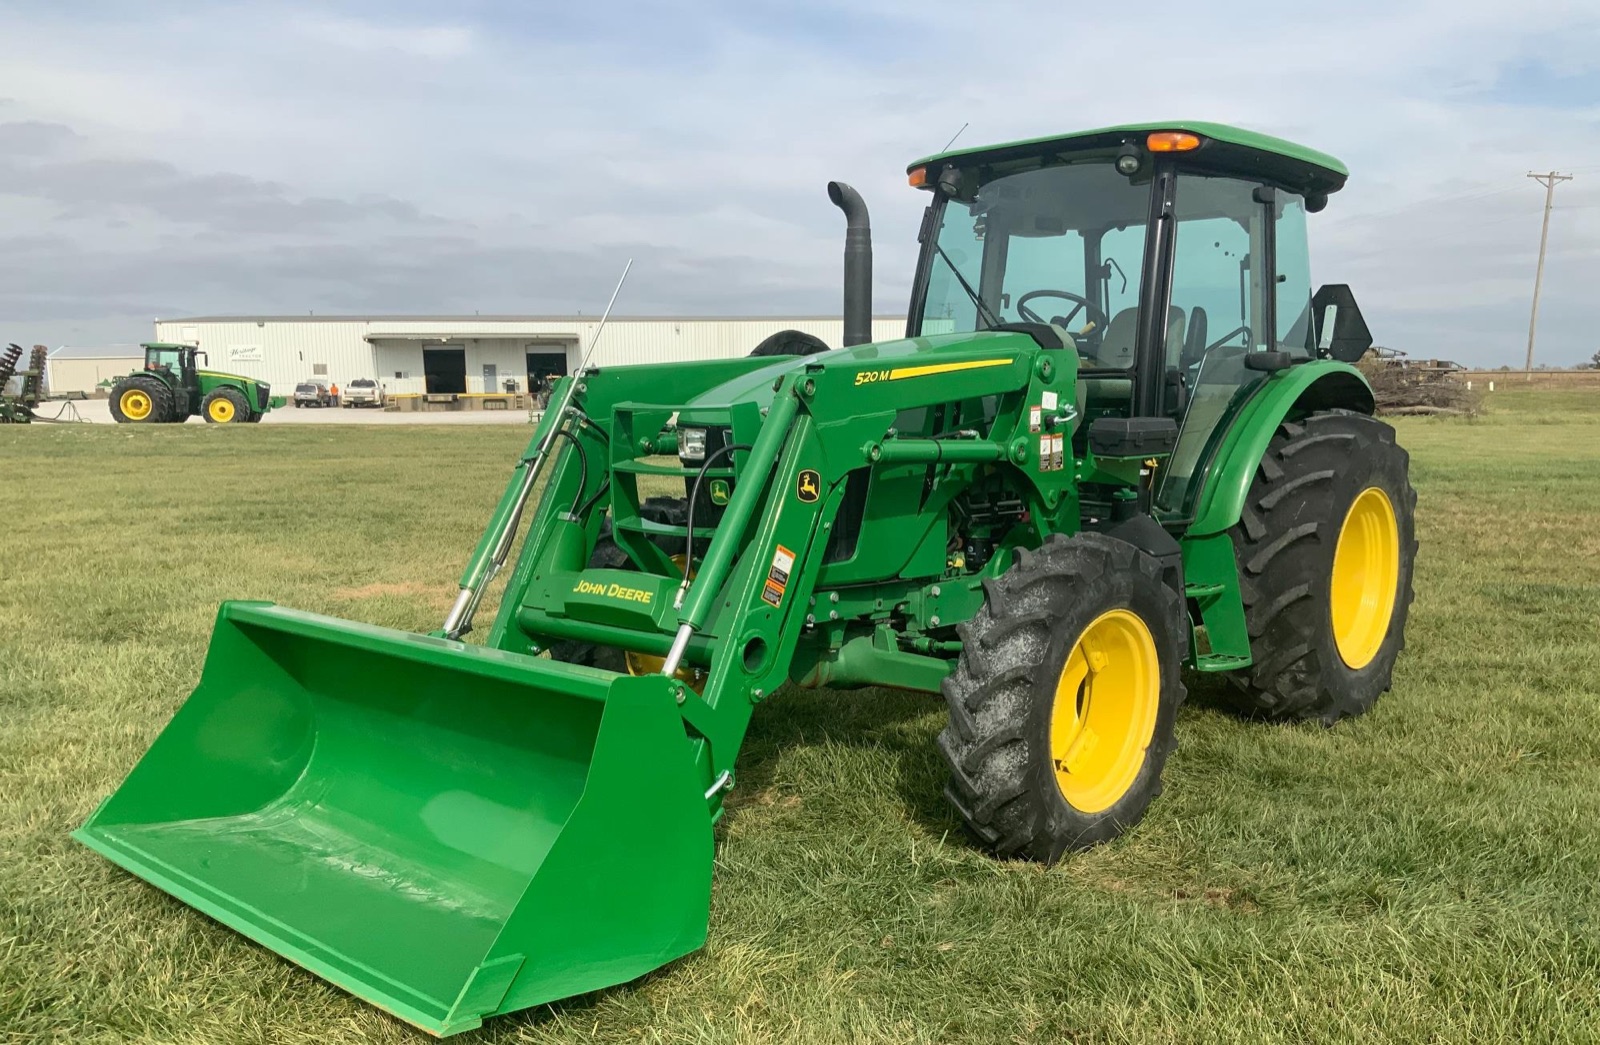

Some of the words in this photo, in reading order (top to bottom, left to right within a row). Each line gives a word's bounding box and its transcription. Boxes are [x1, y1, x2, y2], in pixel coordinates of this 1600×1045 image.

[854, 371, 878, 386] 520
[573, 580, 607, 596] JOHN
[607, 583, 653, 603] DEERE
